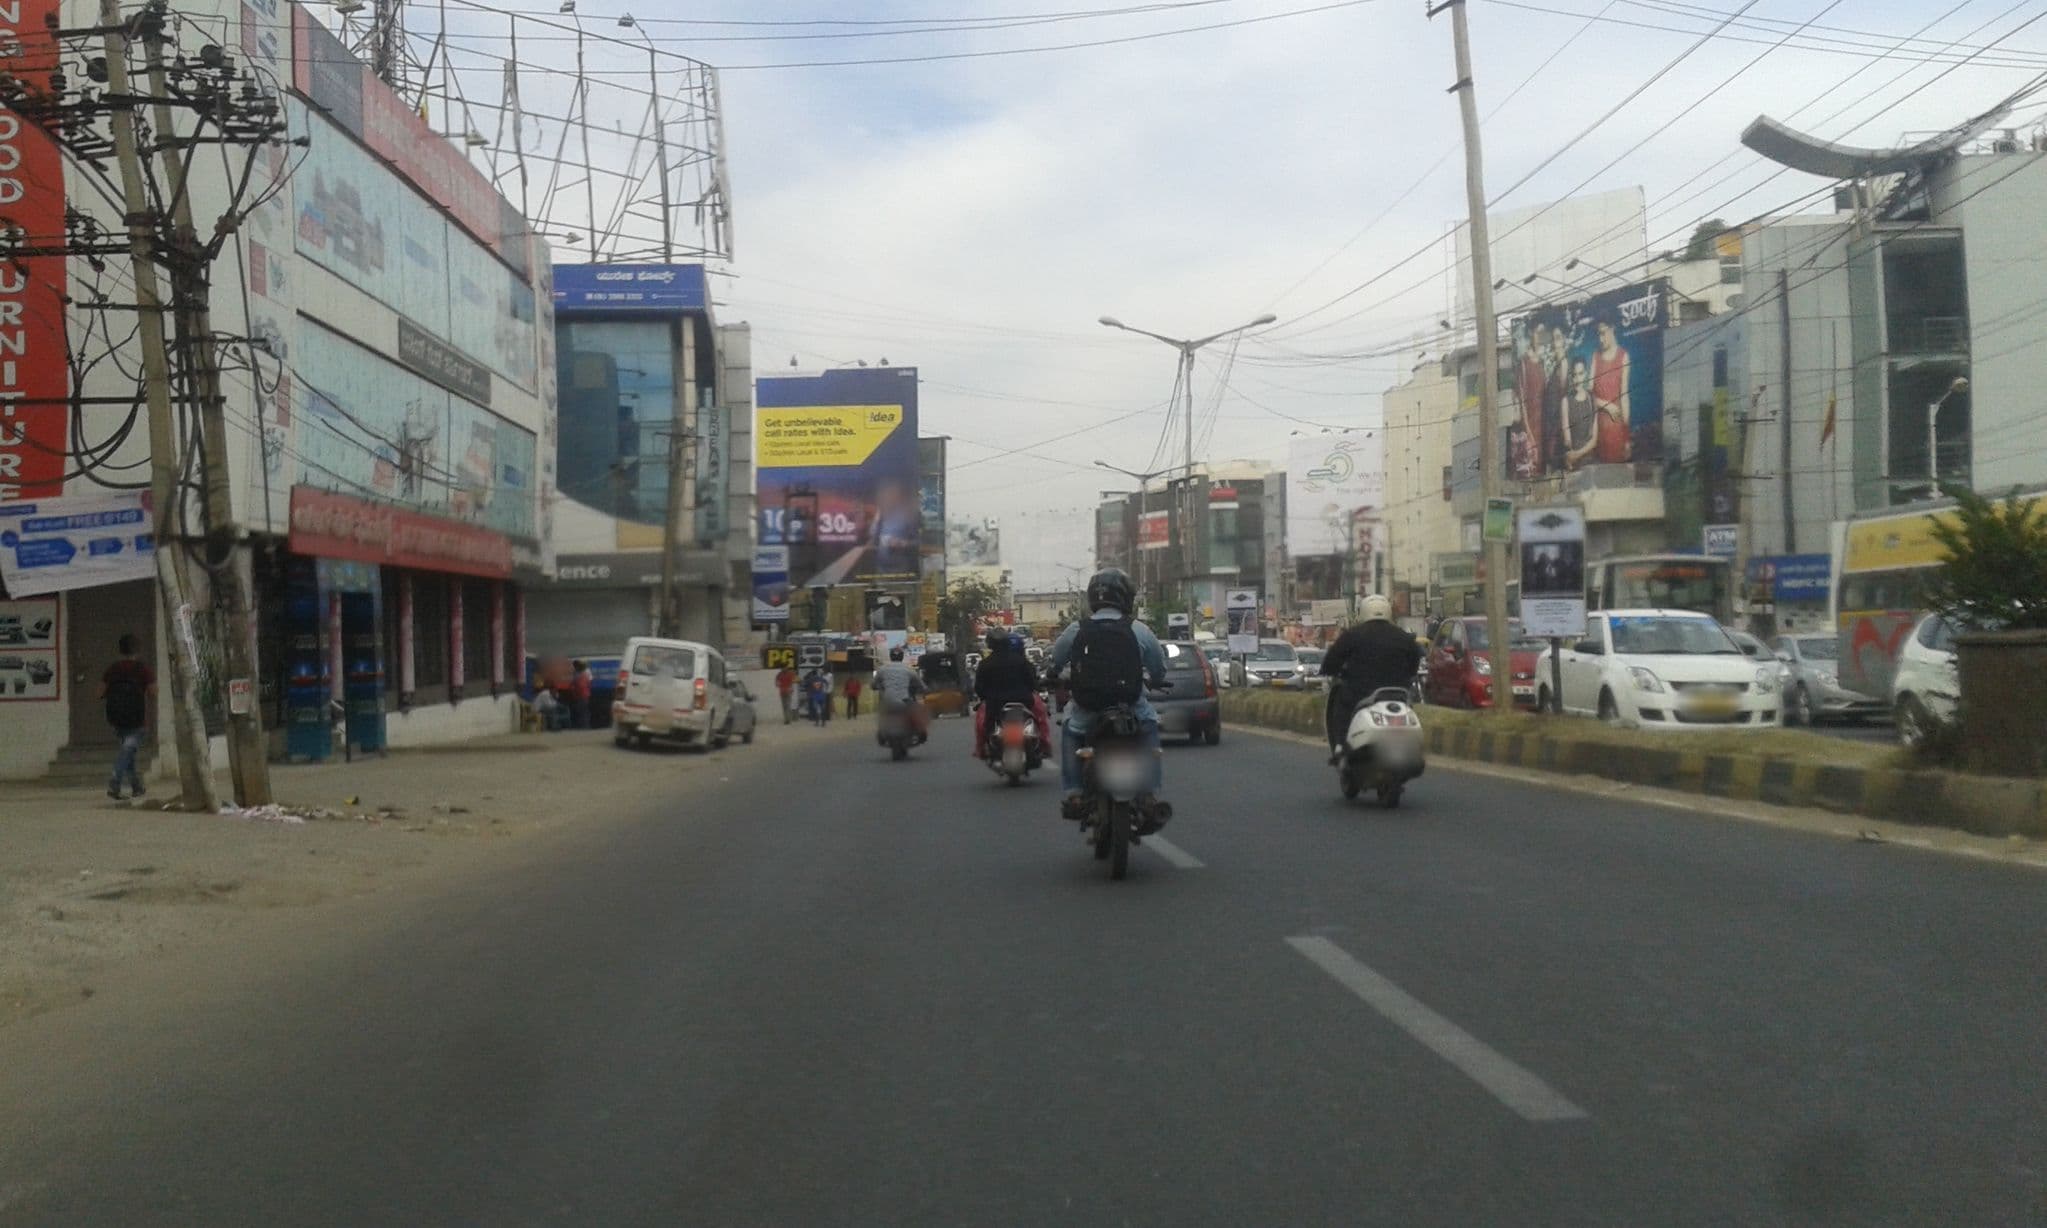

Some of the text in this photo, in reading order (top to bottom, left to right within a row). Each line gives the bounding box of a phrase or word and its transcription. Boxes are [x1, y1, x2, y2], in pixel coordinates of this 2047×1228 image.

[764, 417, 842, 428] Get unbelievable
[764, 429, 782, 438] call
[783, 429, 808, 437] rates
[811, 427, 832, 436] with
[818, 512, 857, 533] 30p
[767, 649, 794, 668] PG
